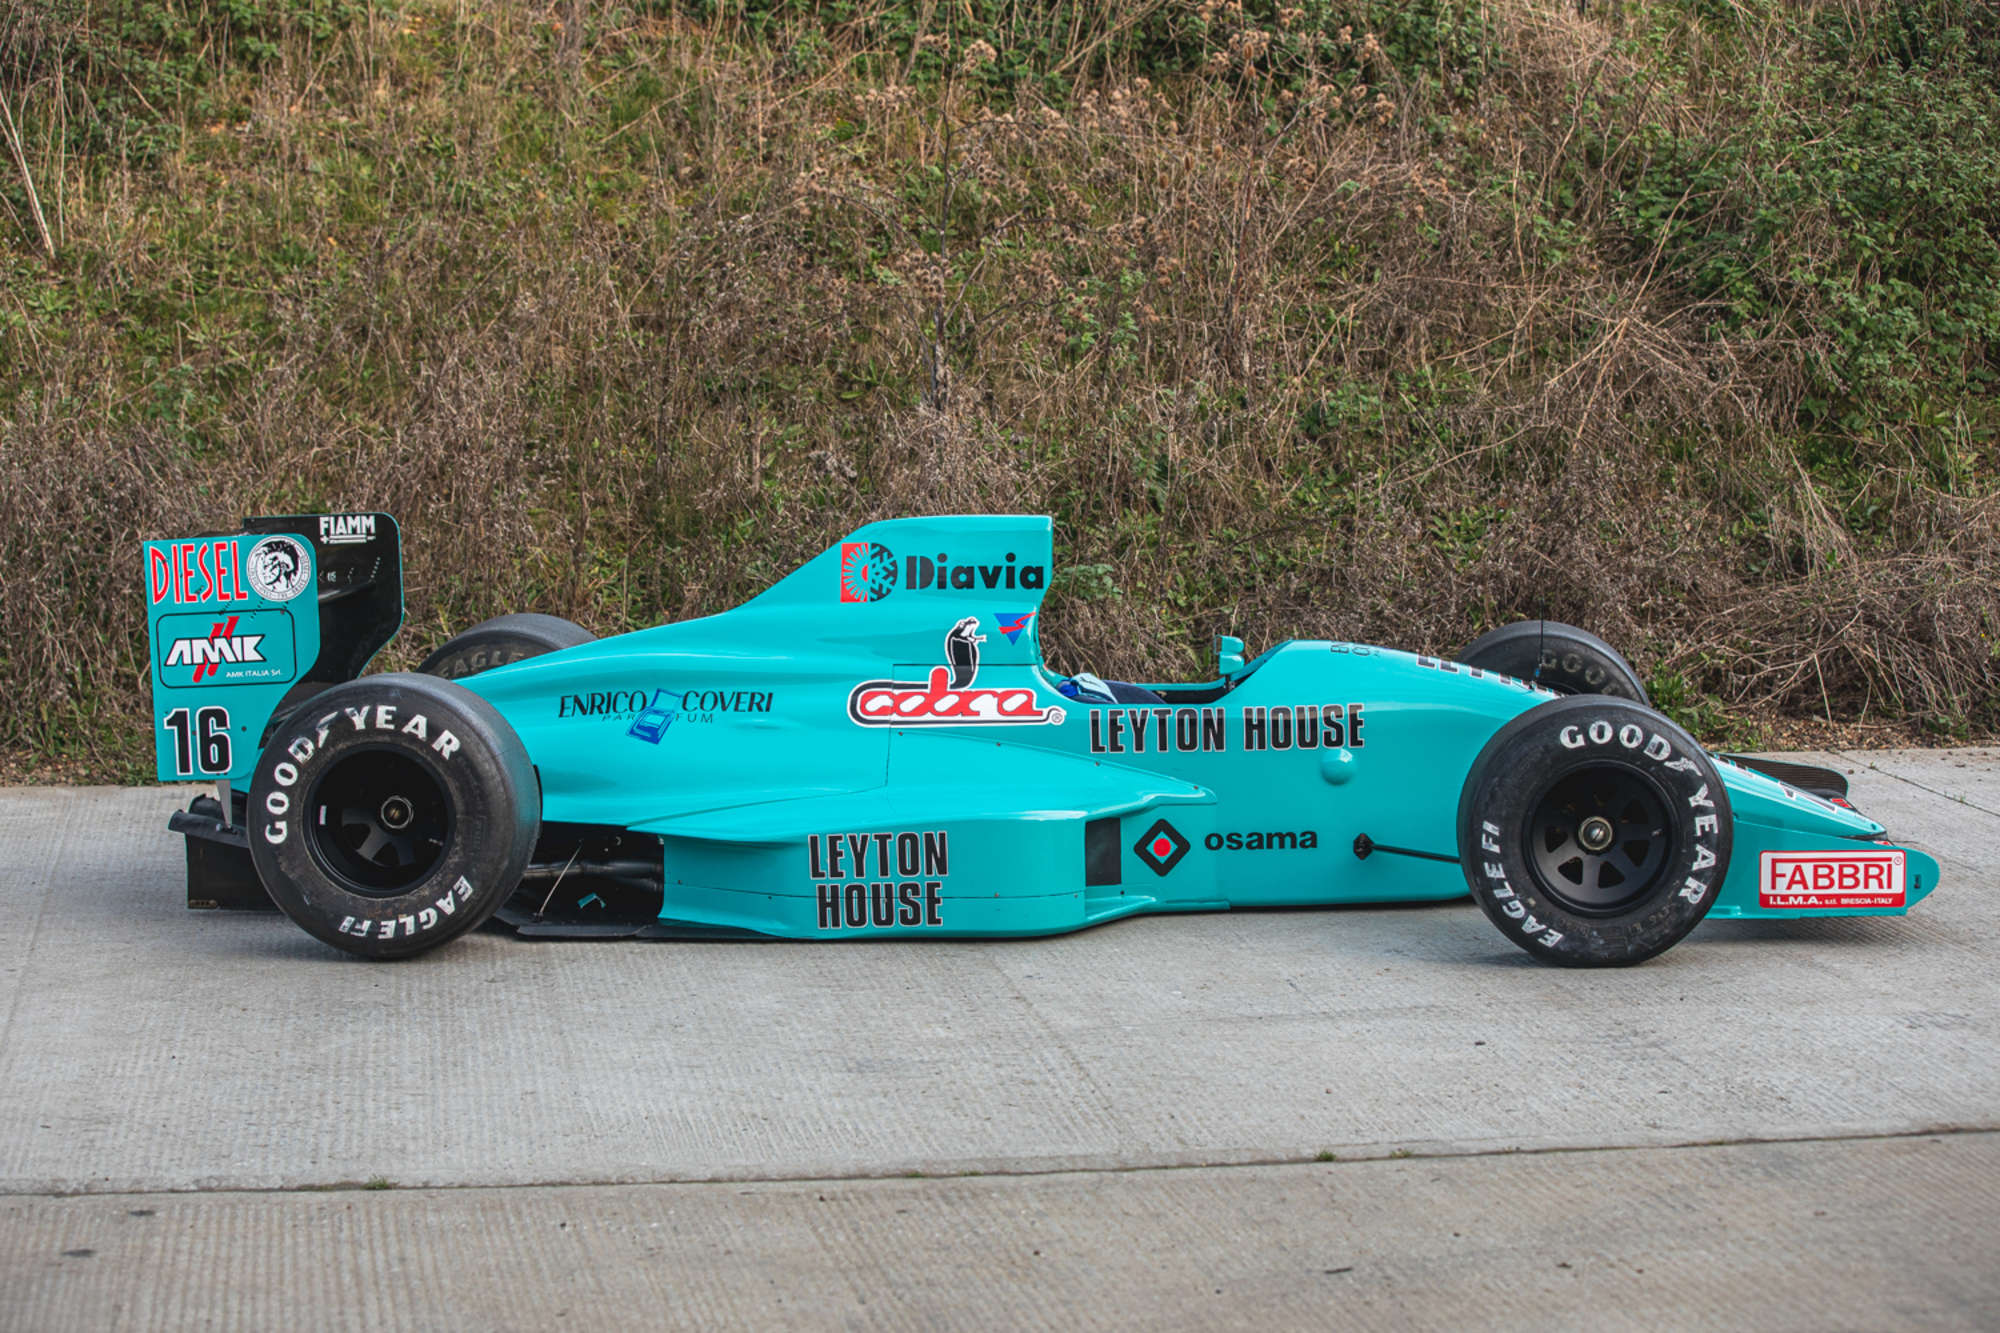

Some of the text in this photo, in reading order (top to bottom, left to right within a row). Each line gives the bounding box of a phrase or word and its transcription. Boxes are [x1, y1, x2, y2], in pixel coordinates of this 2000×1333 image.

[320, 515, 375, 535] FIAMM
[150, 540, 249, 604] DIESEL
[906, 553, 1044, 590] Diavia
[164, 634, 267, 667] AMK
[245, 669, 269, 677] ITALIA
[860, 667, 1043, 717] cobra
[558, 690, 774, 718] ENRICO COVERI
[163, 705, 233, 776] 16
[1089, 703, 1366, 753] LEYTON HOUSE
[808, 831, 949, 880] LEYTON
[1204, 830, 1318, 850] osama
[1771, 857, 1892, 890] FABBRI
[377, 875, 474, 940] EAGLE
[816, 881, 943, 929] HOUSE
[1483, 862, 1564, 948] EAGLE
[1769, 895, 1823, 905] I.L.M.A.
